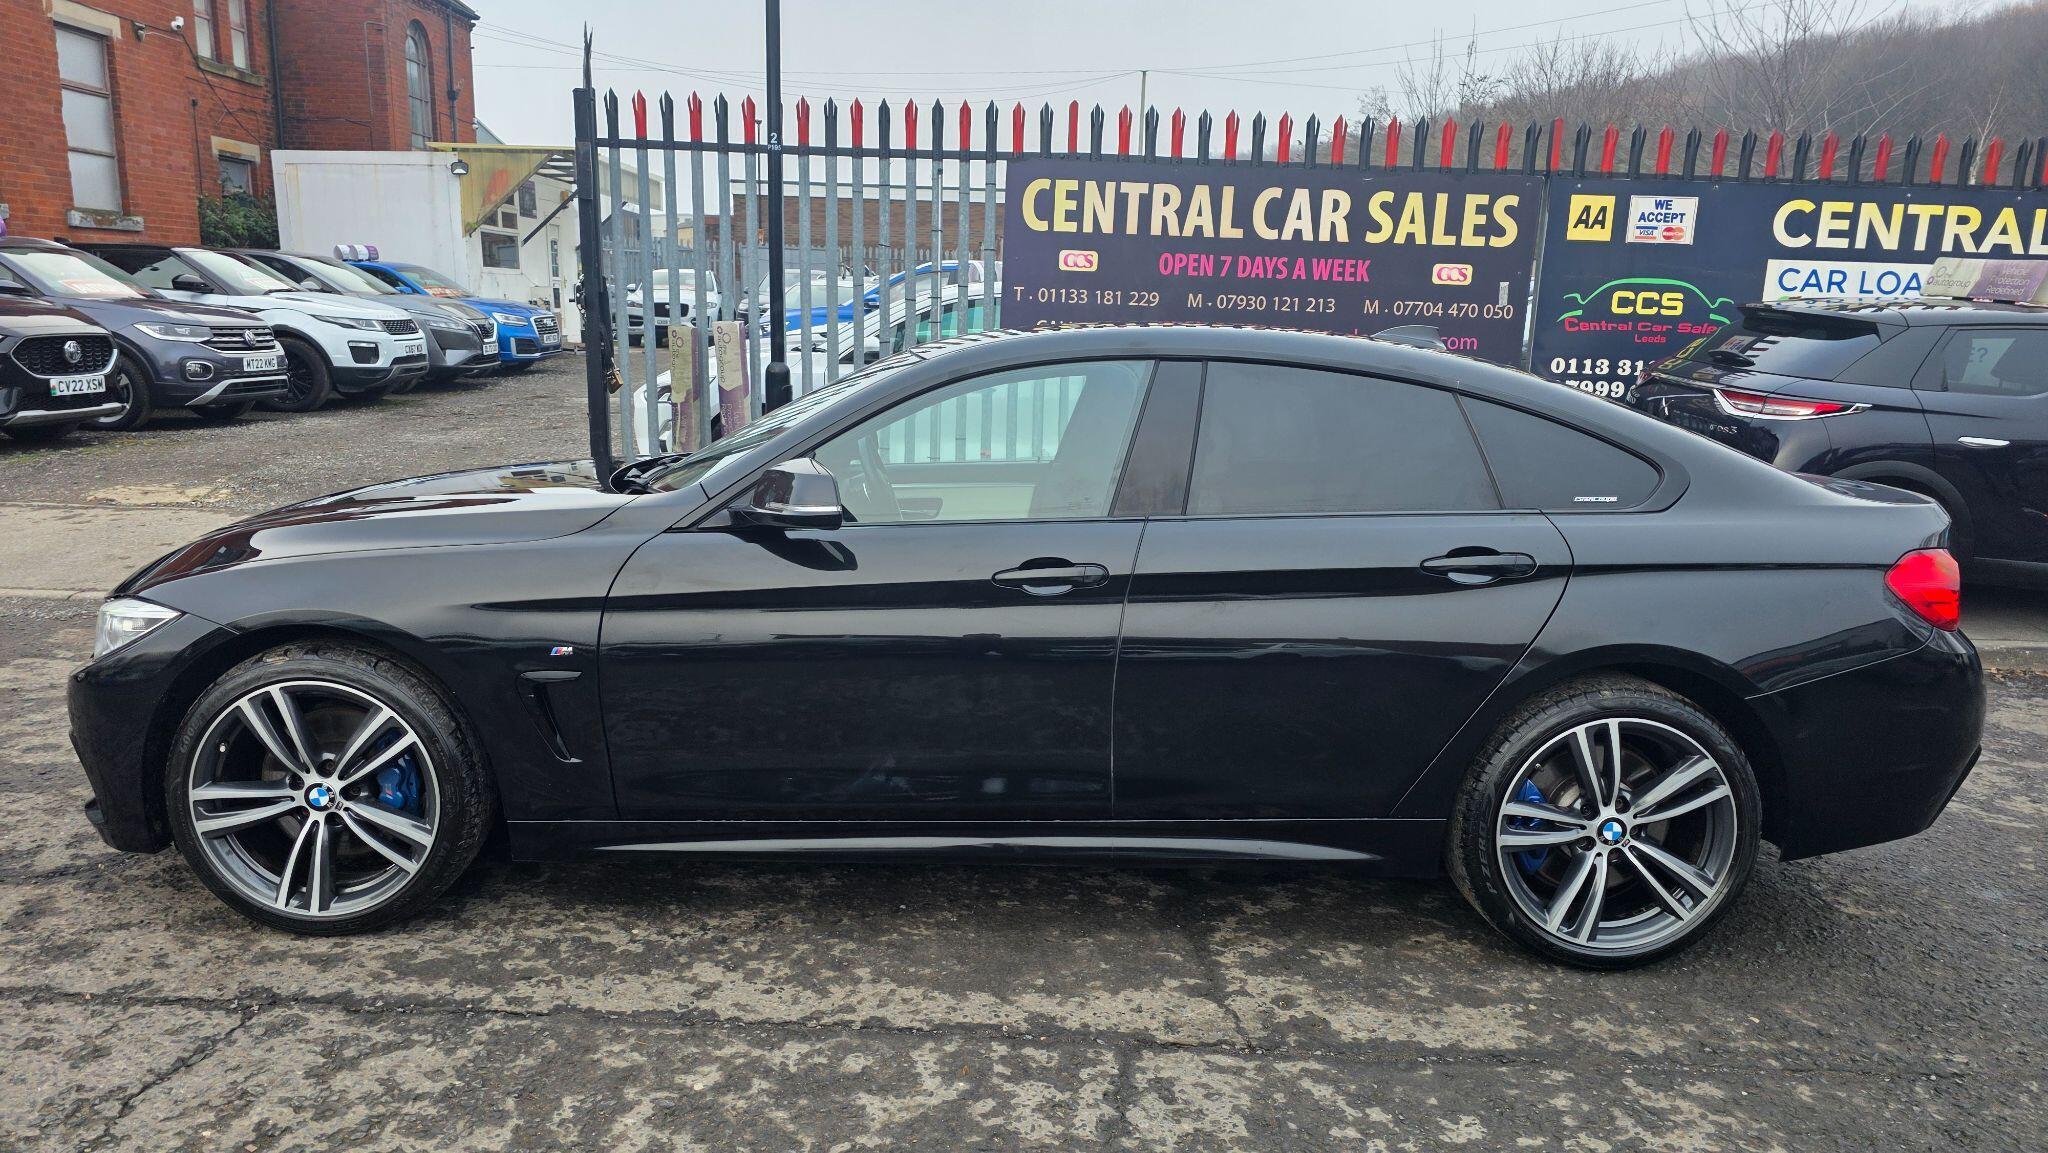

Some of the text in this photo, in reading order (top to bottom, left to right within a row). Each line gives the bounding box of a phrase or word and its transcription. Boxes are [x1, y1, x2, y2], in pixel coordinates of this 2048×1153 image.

[770, 132, 778, 144] 2
[1022, 178, 1520, 248] CENTRAL CAR SALES
[1654, 199, 1674, 211] WE
[1573, 205, 1608, 230] AA
[1637, 211, 1686, 224] ACCEPT
[1773, 199, 2048, 255] CENTRAL
[1158, 252, 1372, 283] OPEN 7 DAYS A WEEK
[1777, 268, 1848, 294] CAR
[1038, 287, 1088, 304] 01133
[1096, 290, 1122, 306] 181
[1128, 291, 1160, 308] 229
[1216, 294, 1267, 311] 07930
[1273, 296, 1299, 312] 121
[1305, 297, 1336, 313] 213
[1611, 290, 1685, 316] CCS
[1393, 301, 1444, 317] 07704
[1448, 303, 1479, 318] 470
[1483, 303, 1514, 320] 050
[1564, 317, 1633, 332] Central
[1637, 322, 1673, 333] Car
[1634, 333, 1667, 344] Leeds
[1551, 357, 1656, 376] 0113 31
[58, 377, 104, 393] CV22 XSM
